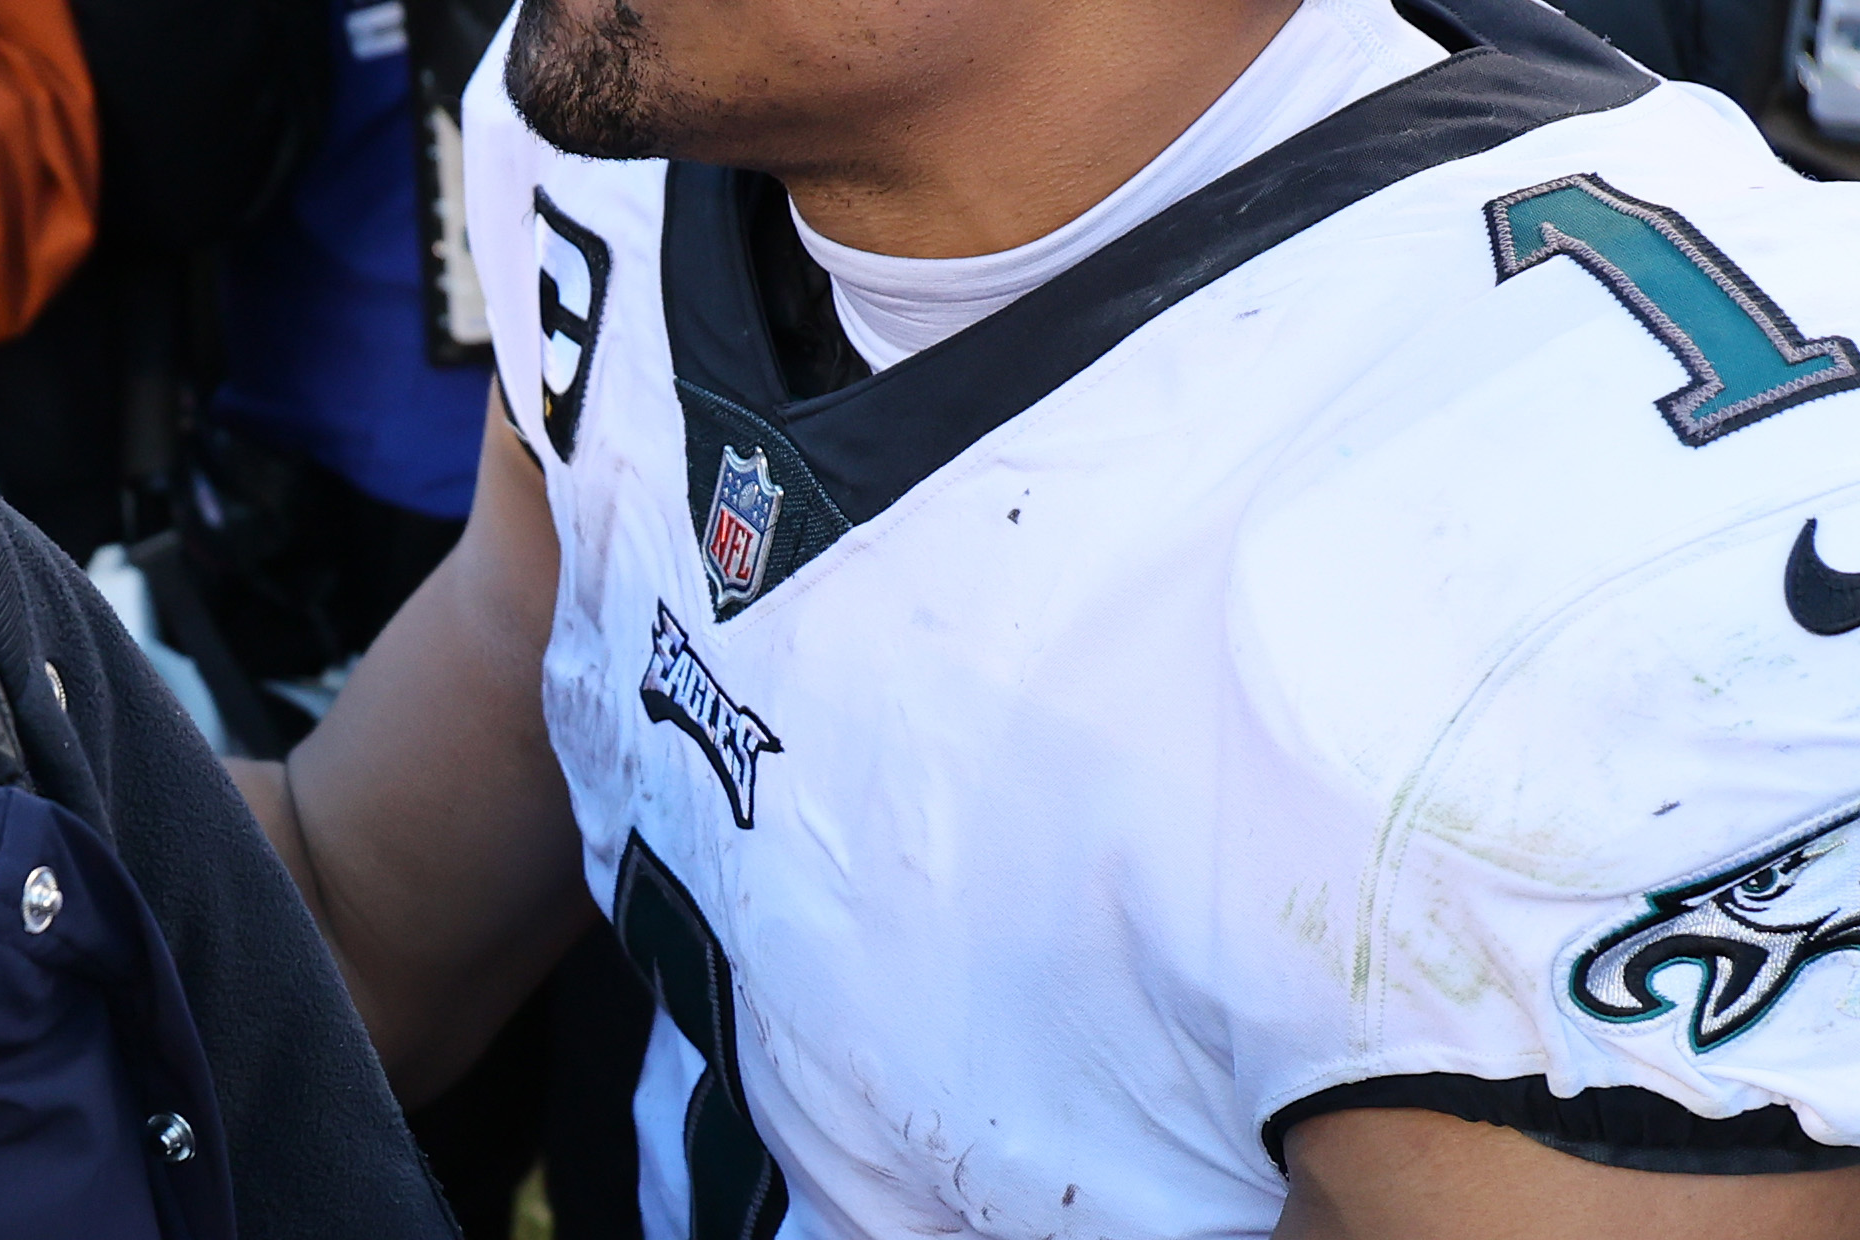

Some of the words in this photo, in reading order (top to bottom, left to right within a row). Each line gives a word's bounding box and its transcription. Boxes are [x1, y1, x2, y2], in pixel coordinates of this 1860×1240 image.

[1481, 171, 1860, 450] 1
[710, 508, 754, 581] NFL
[641, 601, 776, 826] EAGLES
